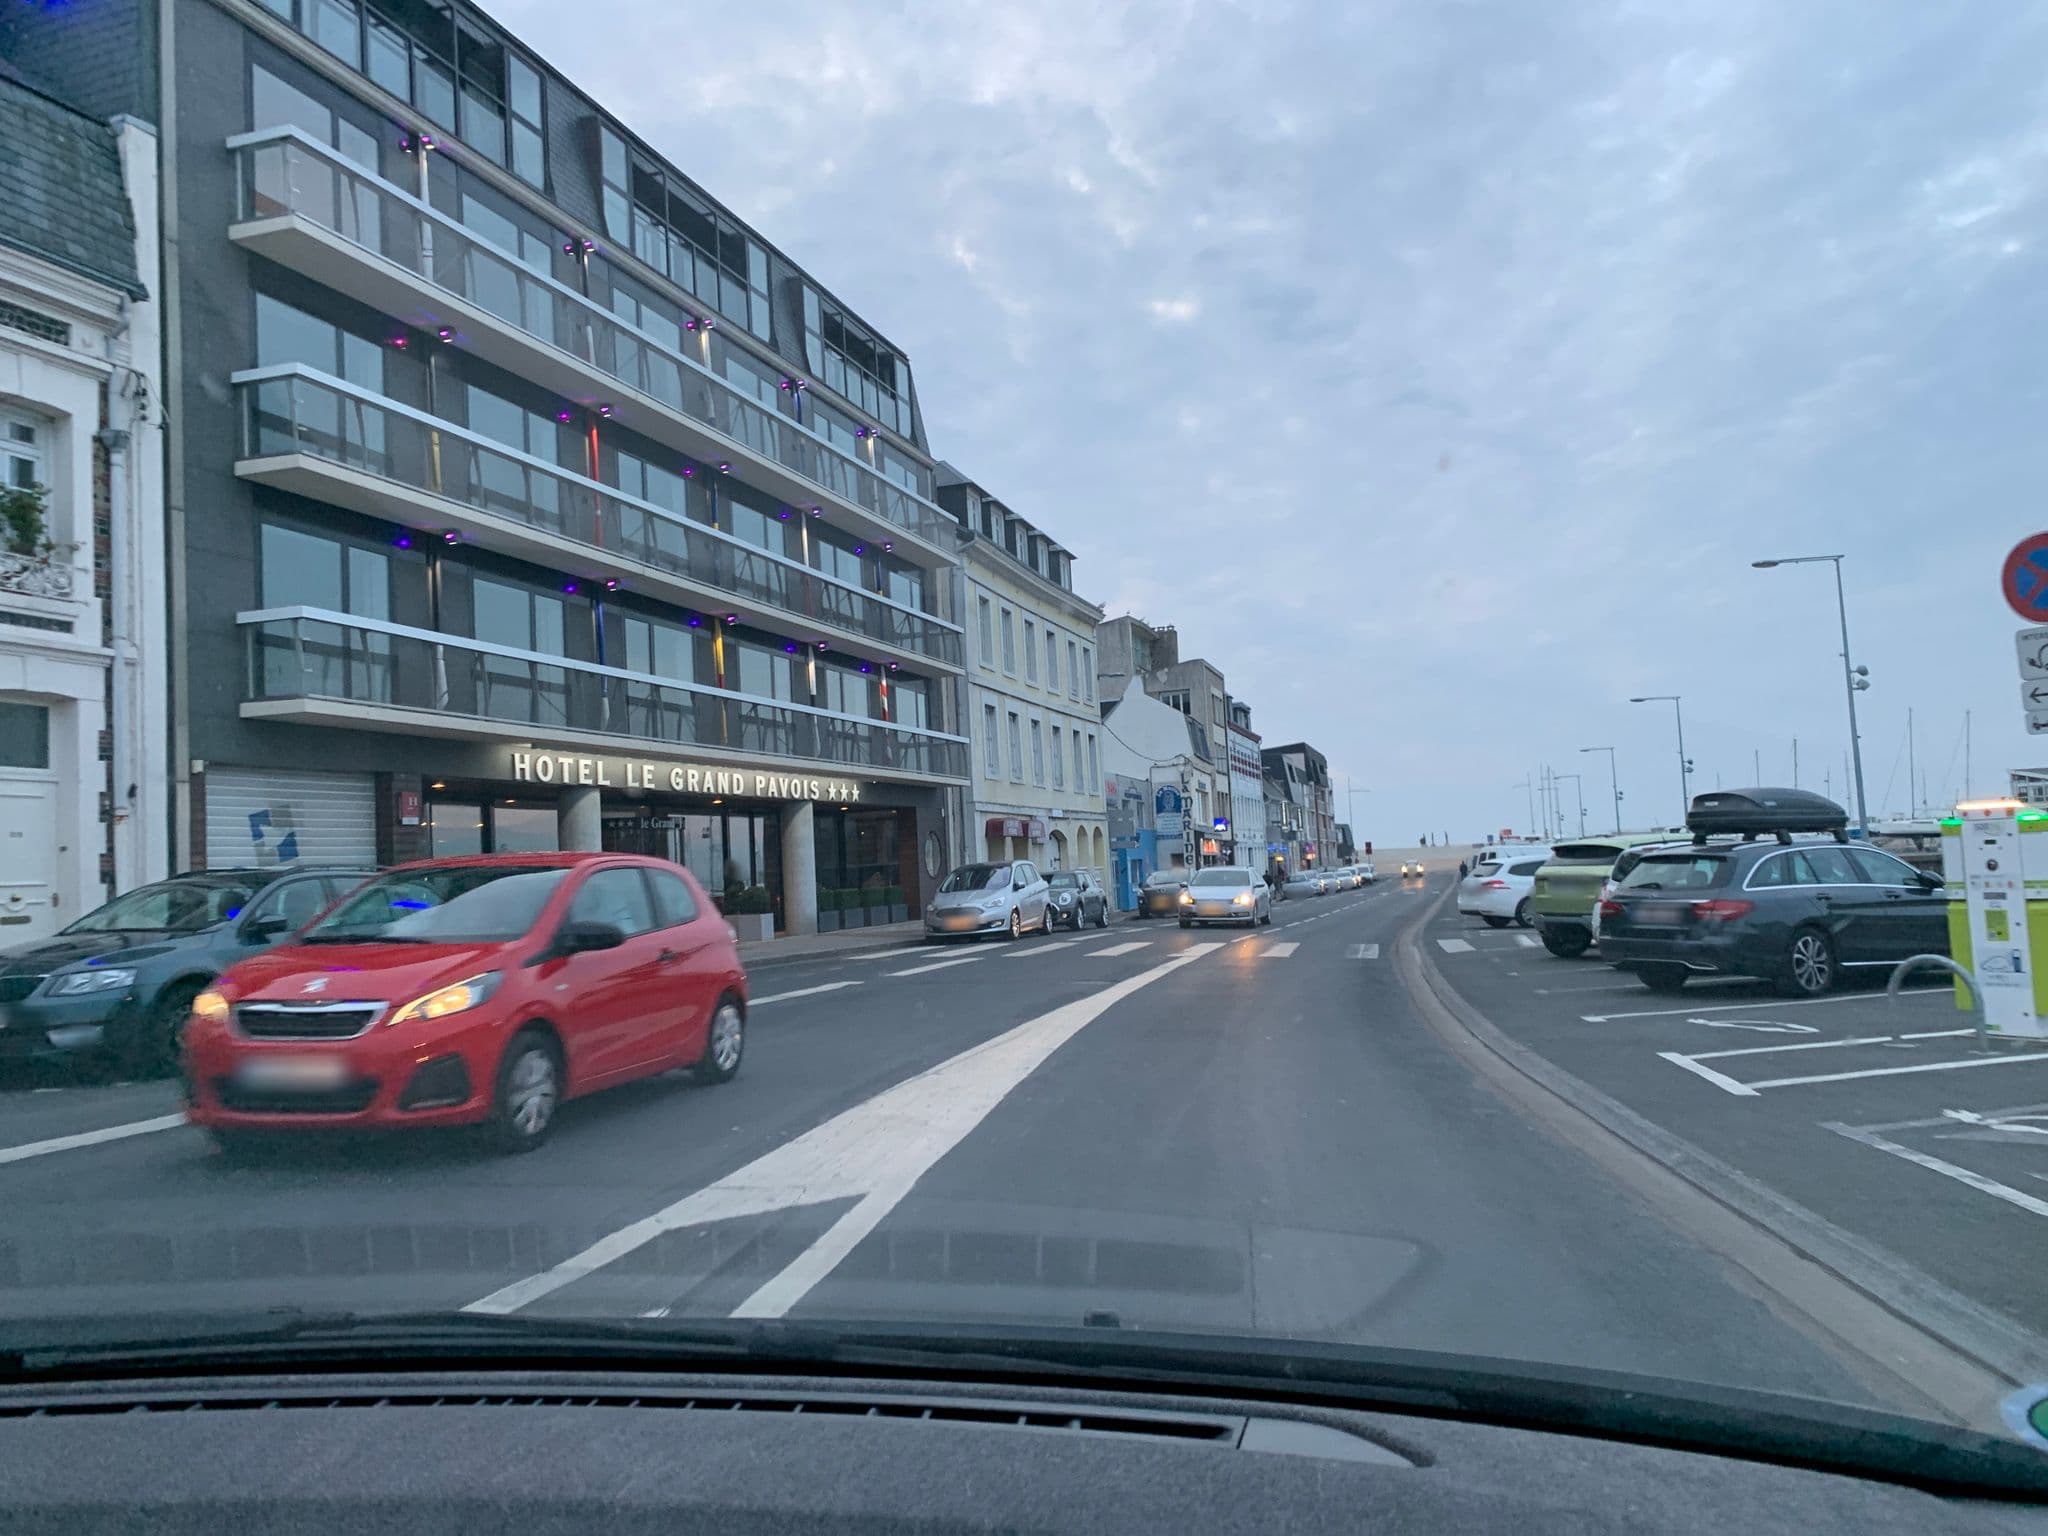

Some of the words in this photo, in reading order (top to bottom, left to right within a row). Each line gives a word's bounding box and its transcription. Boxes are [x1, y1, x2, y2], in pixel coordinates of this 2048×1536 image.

[513, 752, 611, 786] HOTEL
[625, 763, 656, 789] LE
[670, 767, 744, 795] GRAND
[755, 775, 820, 800] PAVOIS
